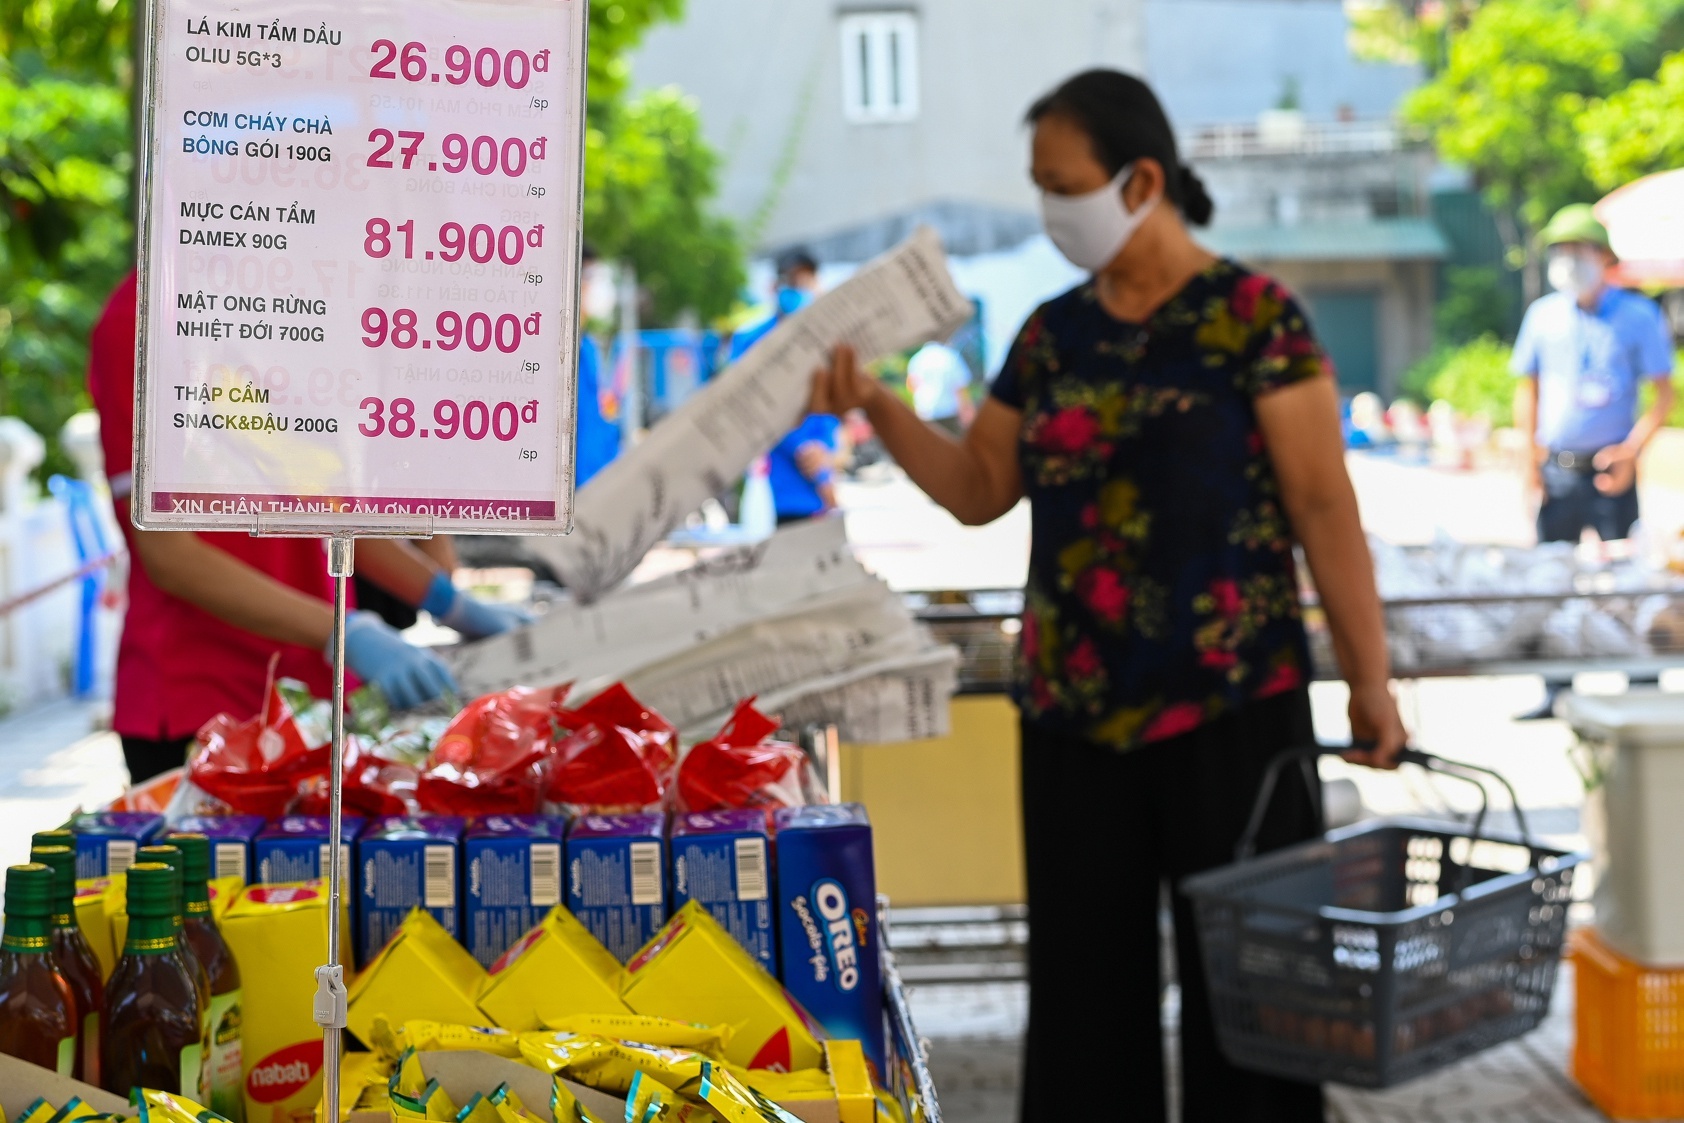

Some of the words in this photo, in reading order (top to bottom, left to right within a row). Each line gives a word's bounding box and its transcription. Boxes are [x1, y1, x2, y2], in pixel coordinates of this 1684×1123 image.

[187, 16, 210, 35] LÁ
[216, 21, 251, 39] KIM
[257, 18, 297, 42] TẨM
[303, 22, 341, 45] DẦU
[186, 46, 230, 64] OLIU
[529, 96, 548, 111] /sp
[184, 110, 228, 128] CƠM
[235, 111, 287, 132] CHÁY
[293, 115, 332, 135] CHÀ
[183, 135, 238, 156] BÔNG
[245, 138, 279, 158] GÓI
[287, 145, 331, 162] 190G
[527, 184, 545, 198] /sp
[181, 202, 224, 222] MỰC
[230, 201, 270, 222] CÁN
[276, 201, 315, 224] TẨM
[180, 229, 247, 248] DAMEX
[251, 233, 287, 250] 90G
[523, 272, 543, 286] /sp
[178, 290, 218, 313] MẬT
[224, 296, 266, 312] ONG
[273, 294, 326, 315] RỪNG
[177, 318, 234, 341] NHIỆT
[239, 320, 272, 340] ĐỚI
[279, 326, 324, 342] 700G
[521, 359, 540, 374] /sp
[174, 383, 222, 406] THẬP
[229, 380, 269, 403] CẨM
[173, 412, 288, 434] SNACK&ĐẬU
[294, 418, 338, 433] 200G
[518, 448, 537, 462] /sp
[172, 499, 204, 515] XIN
[209, 496, 262, 515] CHÂN
[267, 497, 334, 513] THÀNH
[339, 499, 379, 514] CẢM
[459, 502, 521, 521] KHÁCH
[815, 881, 859, 991] OREO
[252, 1060, 310, 1089] nabati
